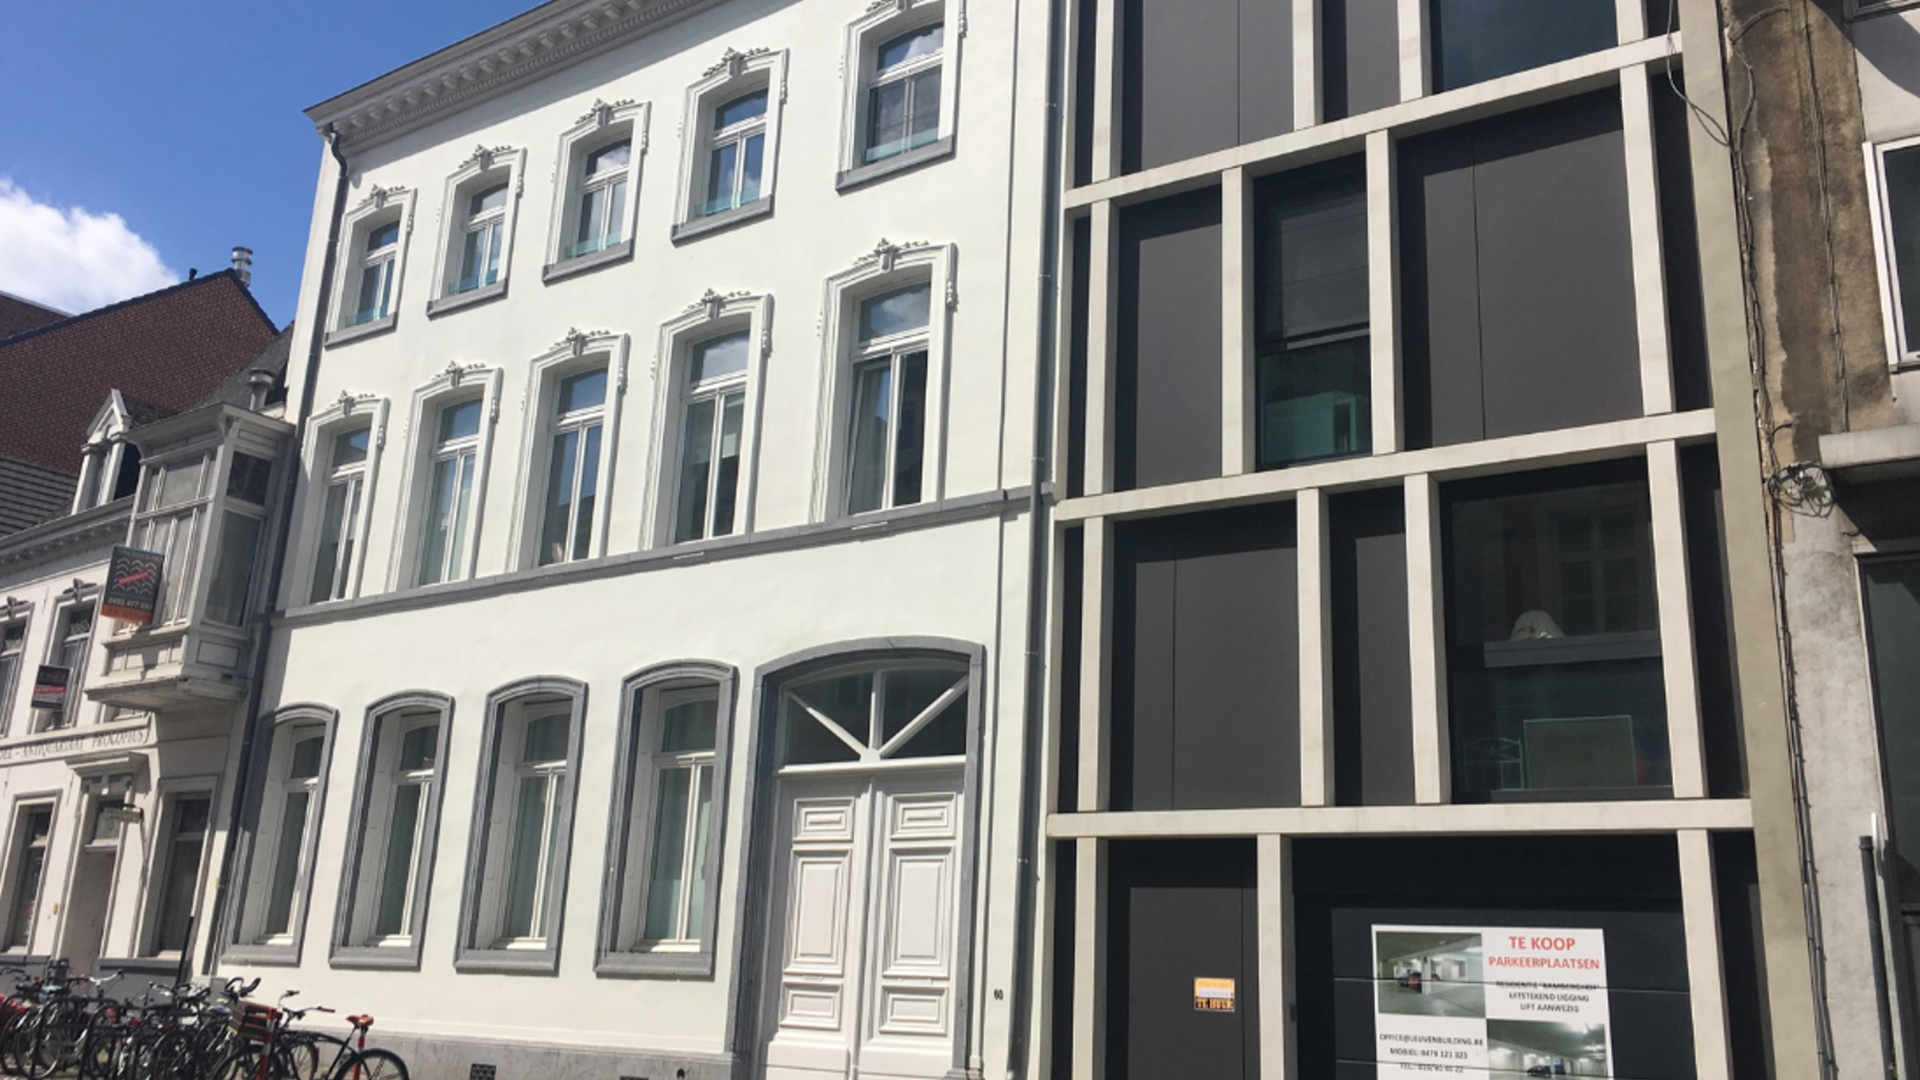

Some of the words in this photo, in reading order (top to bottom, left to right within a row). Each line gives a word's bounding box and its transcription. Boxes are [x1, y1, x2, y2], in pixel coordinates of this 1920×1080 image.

[1509, 936, 1526, 949] TE
[1531, 937, 1576, 951] KOOP
[1488, 956, 1600, 970] PARKEERPLAATSEN
[1509, 992, 1556, 1001] UITSTEKEND
